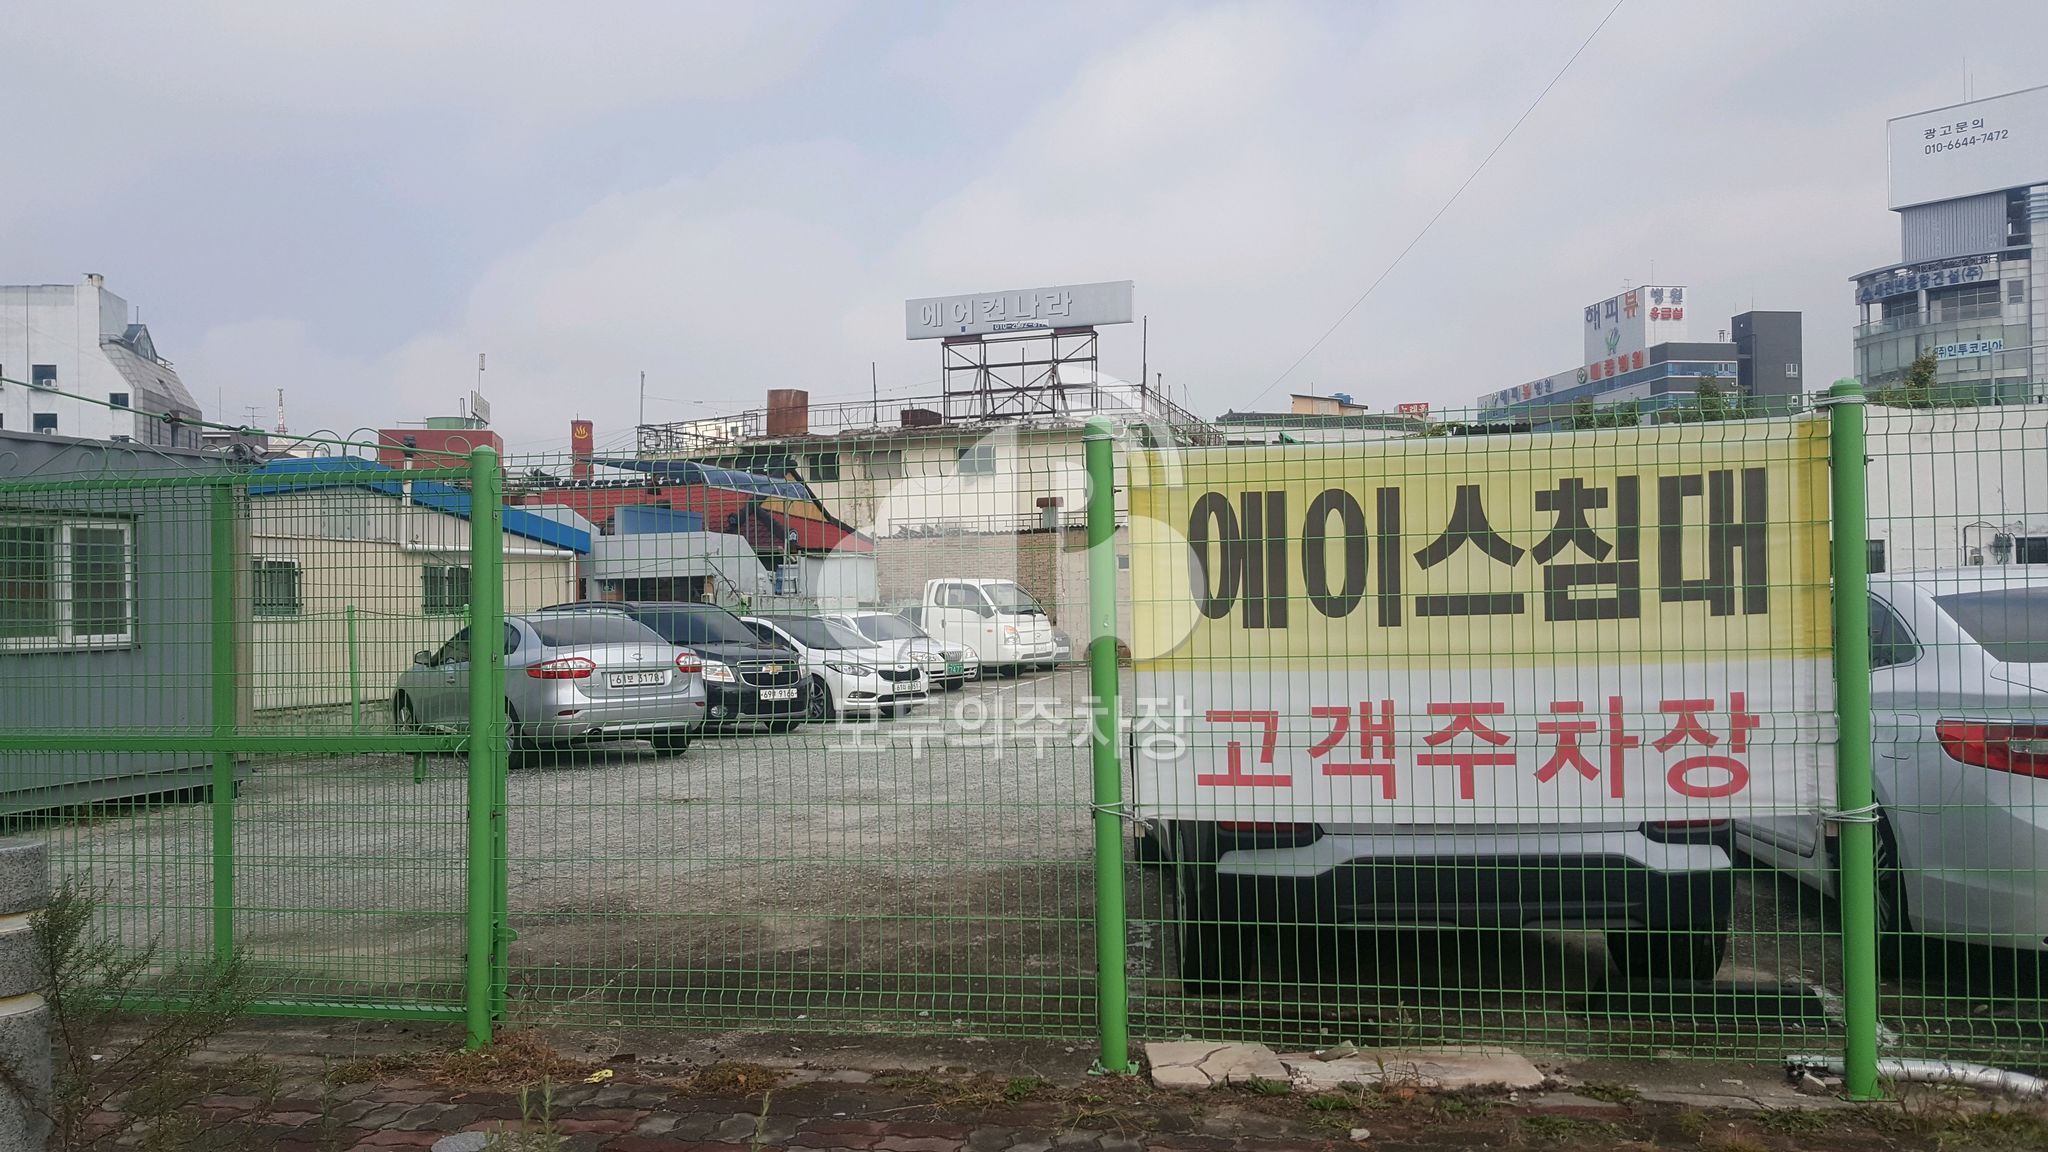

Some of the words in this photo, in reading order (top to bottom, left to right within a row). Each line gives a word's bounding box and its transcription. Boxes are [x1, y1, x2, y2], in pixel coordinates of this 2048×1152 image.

[1923, 118, 1984, 140] 광고문의
[1924, 129, 2009, 155] 010-6644-7472
[919, 291, 1073, 328] 에어컨나라
[1649, 306, 1684, 321] 응급실
[1187, 467, 1768, 630] 에이스침대
[1196, 691, 1761, 800] 고객주차장
